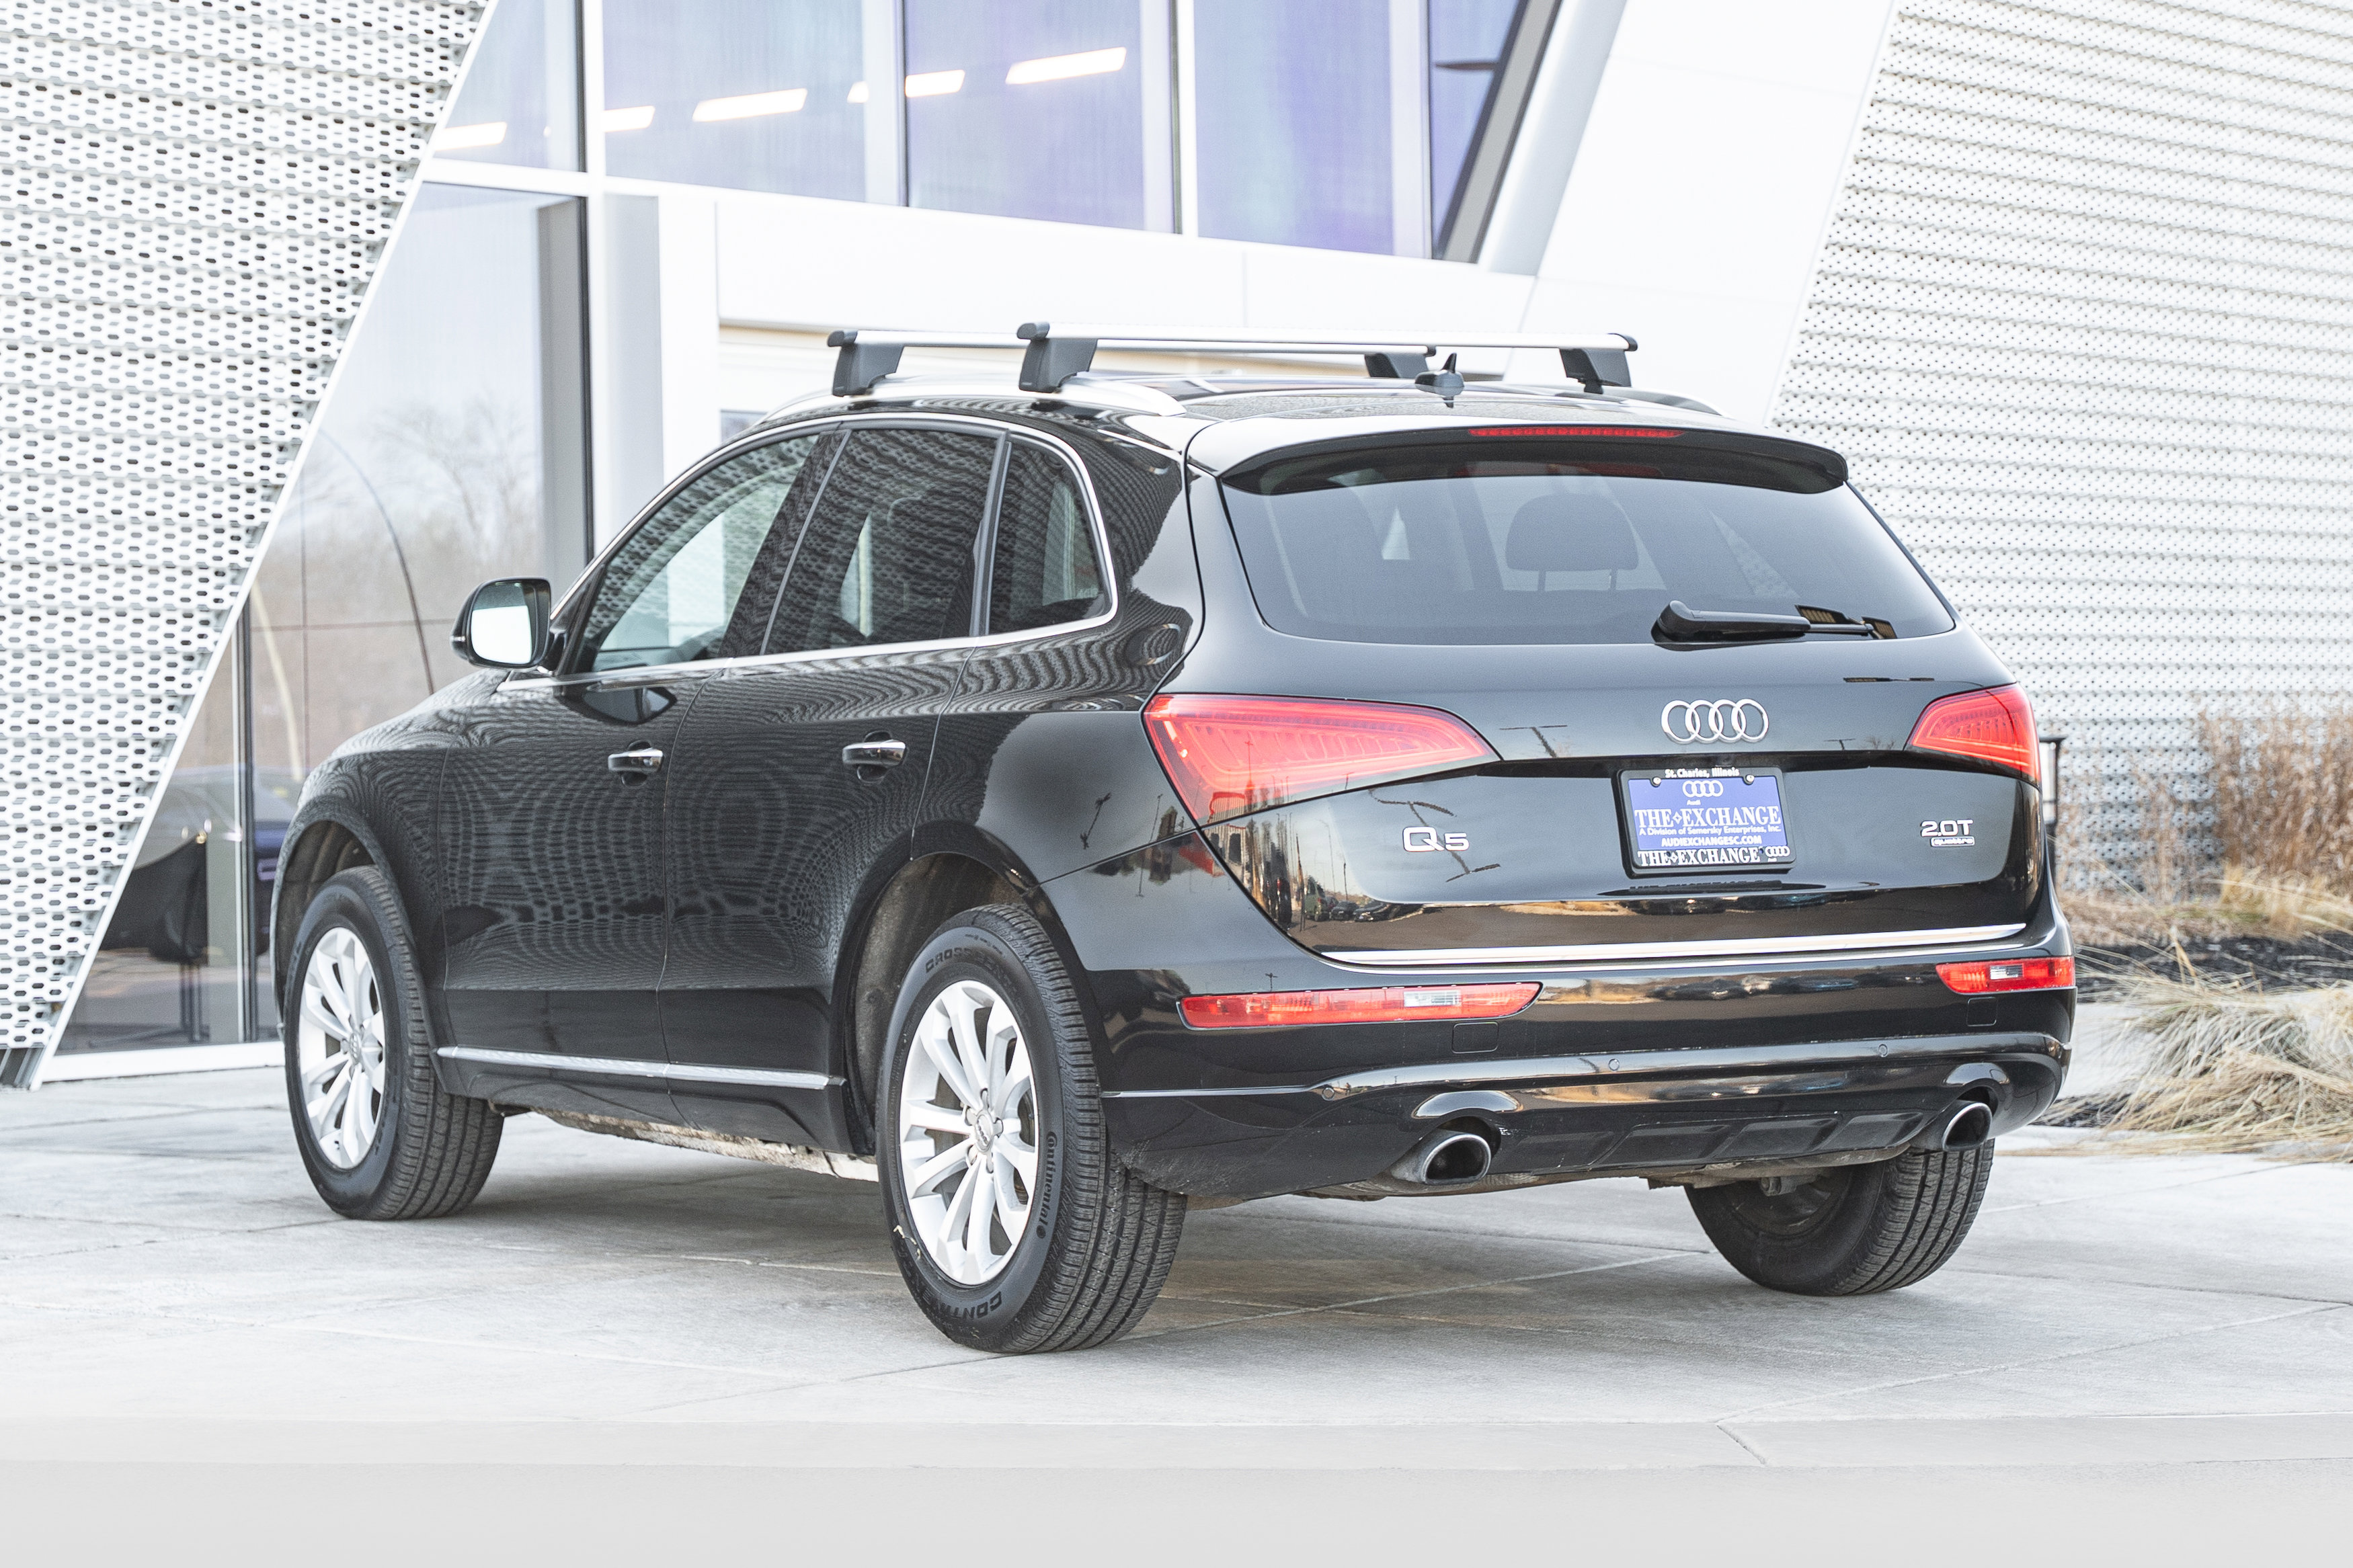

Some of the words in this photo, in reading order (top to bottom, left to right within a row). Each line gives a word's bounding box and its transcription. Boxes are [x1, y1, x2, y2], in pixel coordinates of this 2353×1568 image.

[1665, 769, 1677, 778] St.
[1677, 768, 1710, 778] Charles,
[1712, 767, 1740, 777] Illinois
[1634, 809, 1675, 829] THE
[1681, 805, 1782, 827] EXCHANGE
[1639, 827, 1646, 835] A
[1724, 825, 1767, 835] Enterprises,
[1767, 825, 1782, 833] Inc.
[1921, 819, 1974, 837] 2.0T
[1402, 826, 1470, 852] Q5
[1661, 835, 1762, 848] AUDIEXCHANGESC.COM
[1637, 850, 1671, 867] THE
[1677, 846, 1761, 866] EXCHANGE
